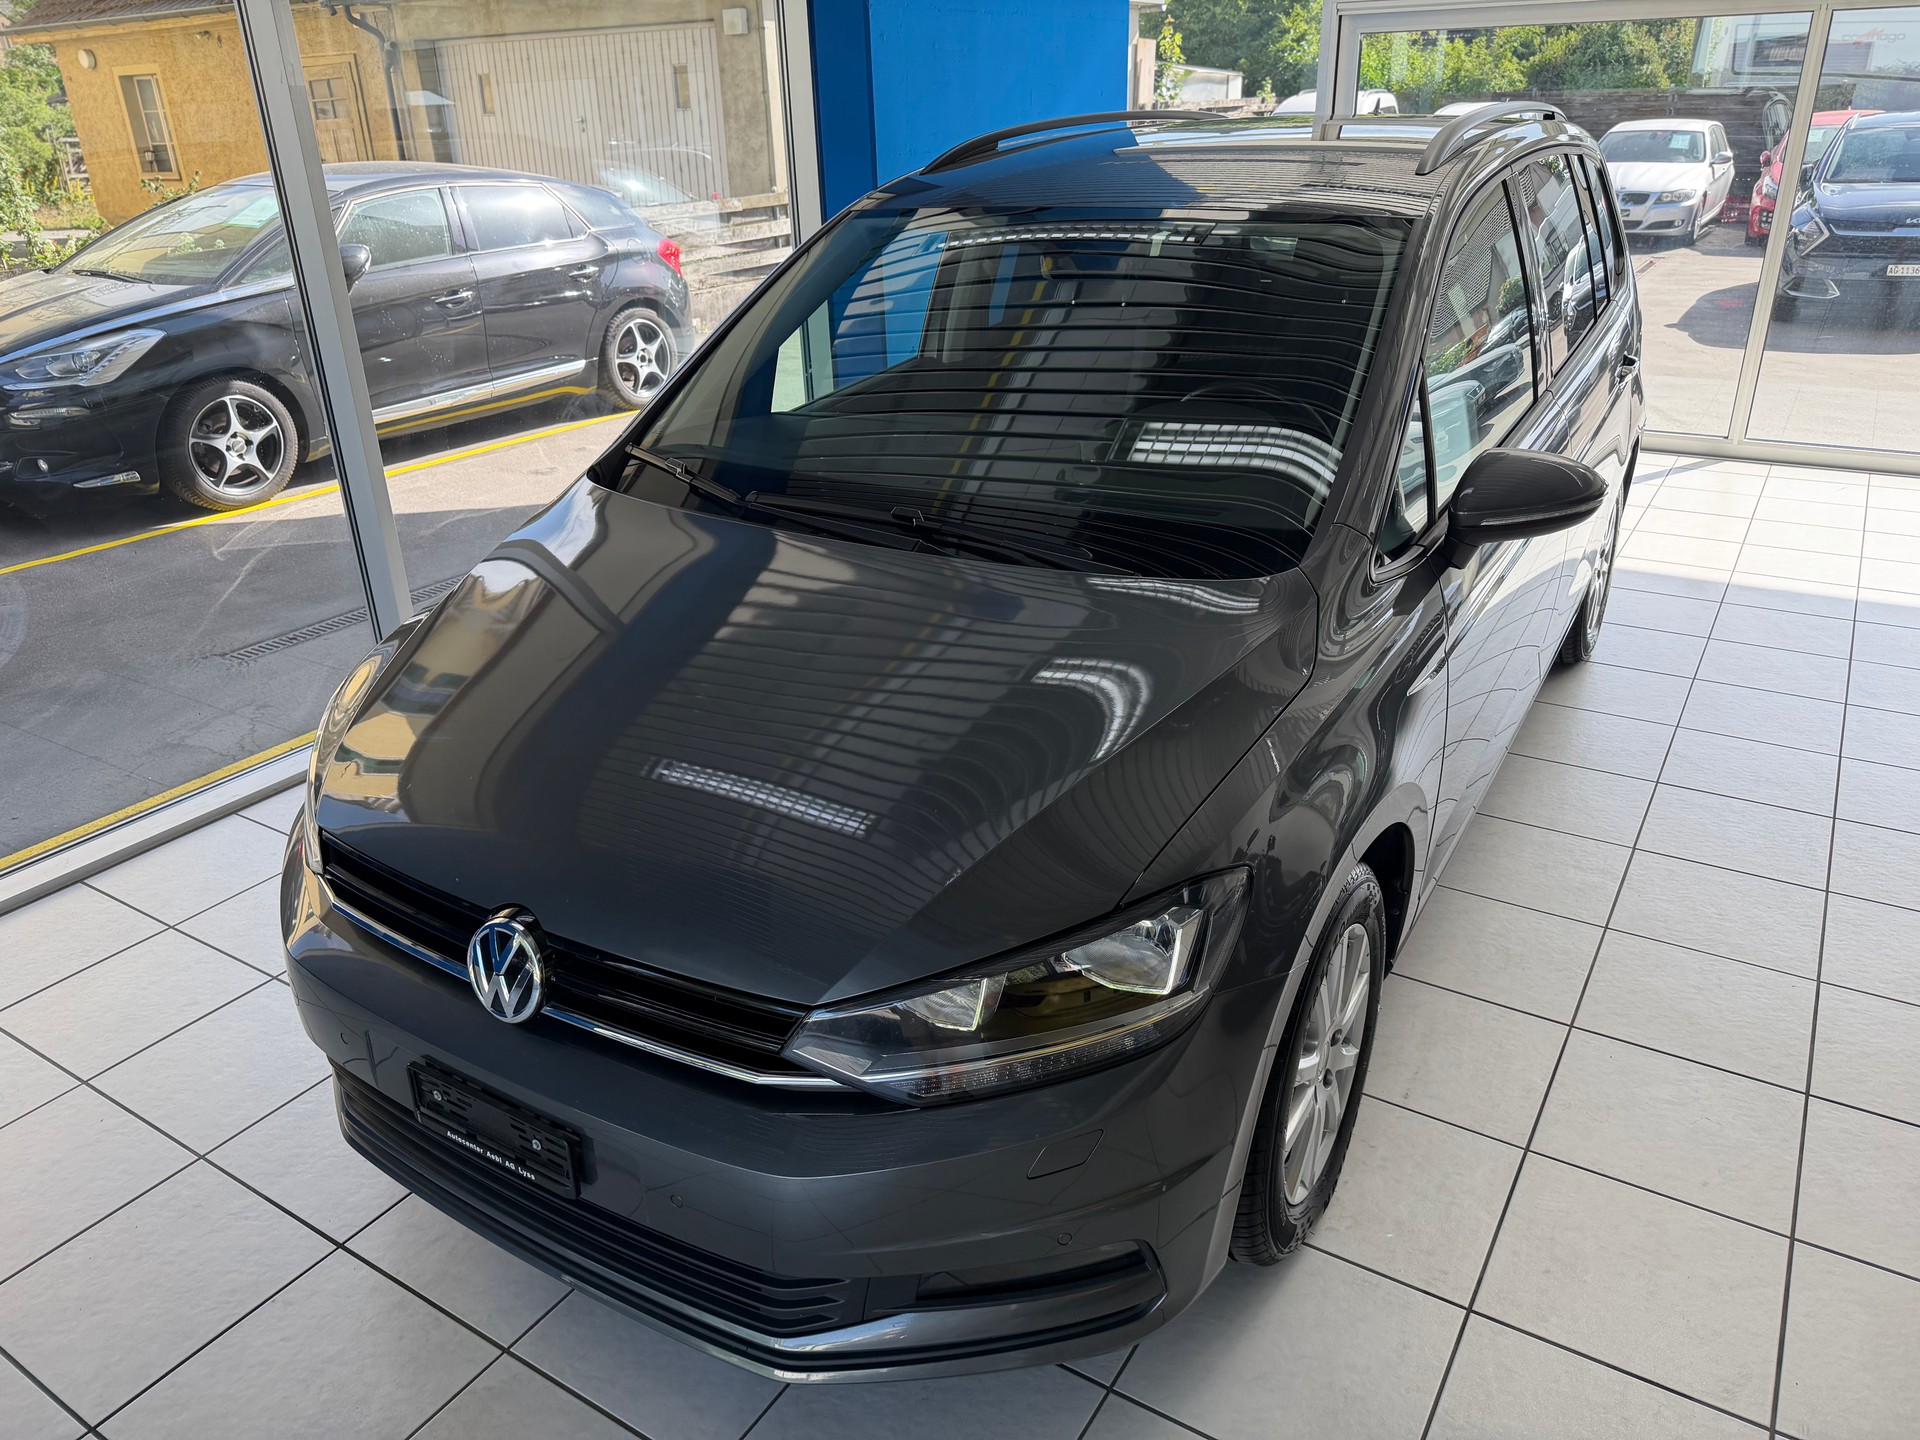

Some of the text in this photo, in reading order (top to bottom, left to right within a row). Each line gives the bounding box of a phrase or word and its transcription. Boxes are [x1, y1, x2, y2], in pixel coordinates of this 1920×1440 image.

[447, 1130, 536, 1180] Autocenter Aebi AG Lyss
